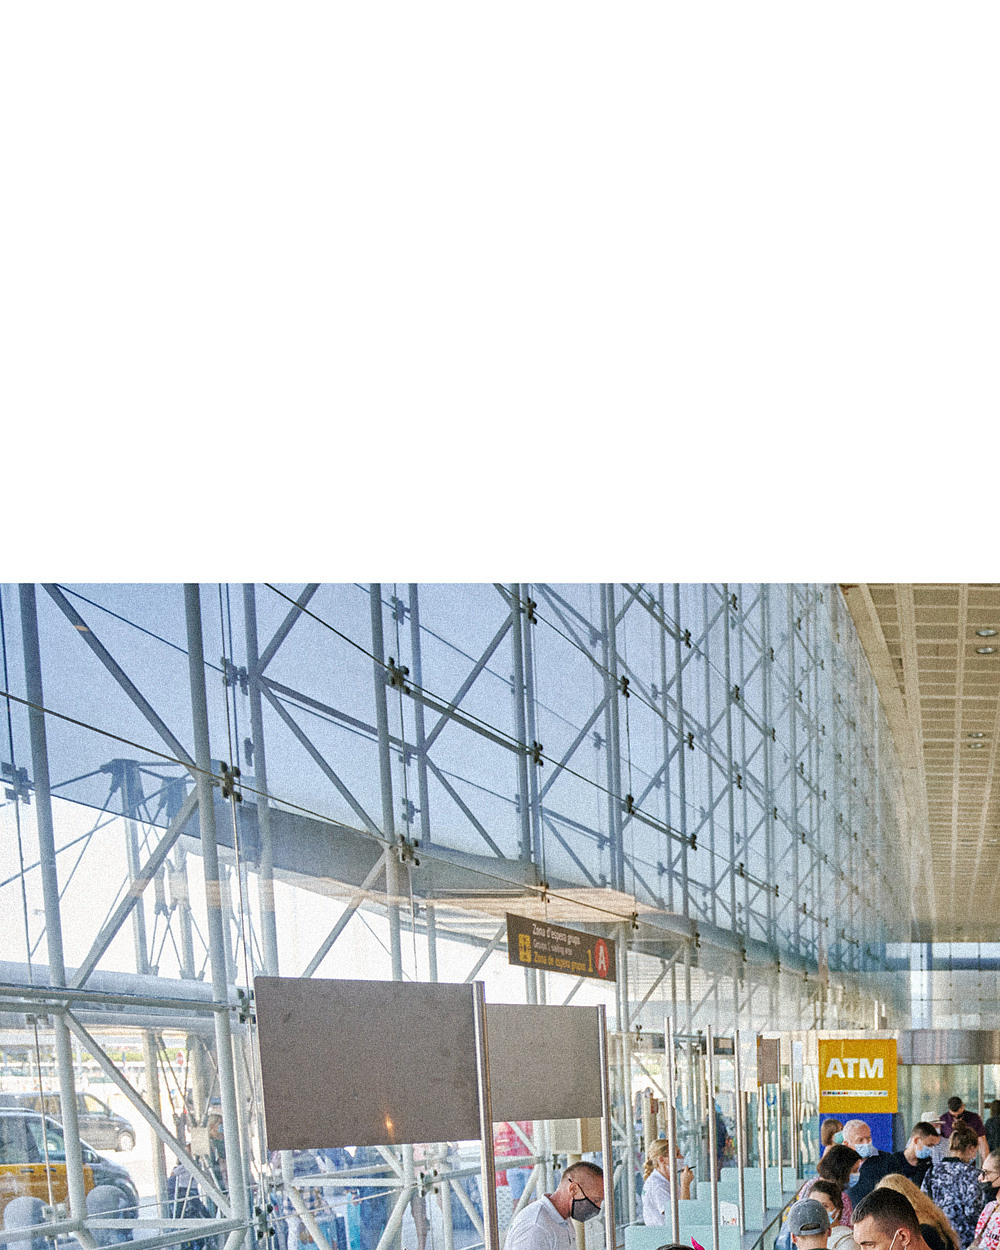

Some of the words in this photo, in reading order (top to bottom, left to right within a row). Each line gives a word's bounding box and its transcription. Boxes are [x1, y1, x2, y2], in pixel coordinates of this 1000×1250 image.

[532, 923, 545, 937] Zona
[534, 951, 546, 964] Zona
[547, 953, 554, 966] de
[587, 949, 593, 972] 1
[598, 945, 607, 971] A
[826, 1058, 884, 1078] ATM
